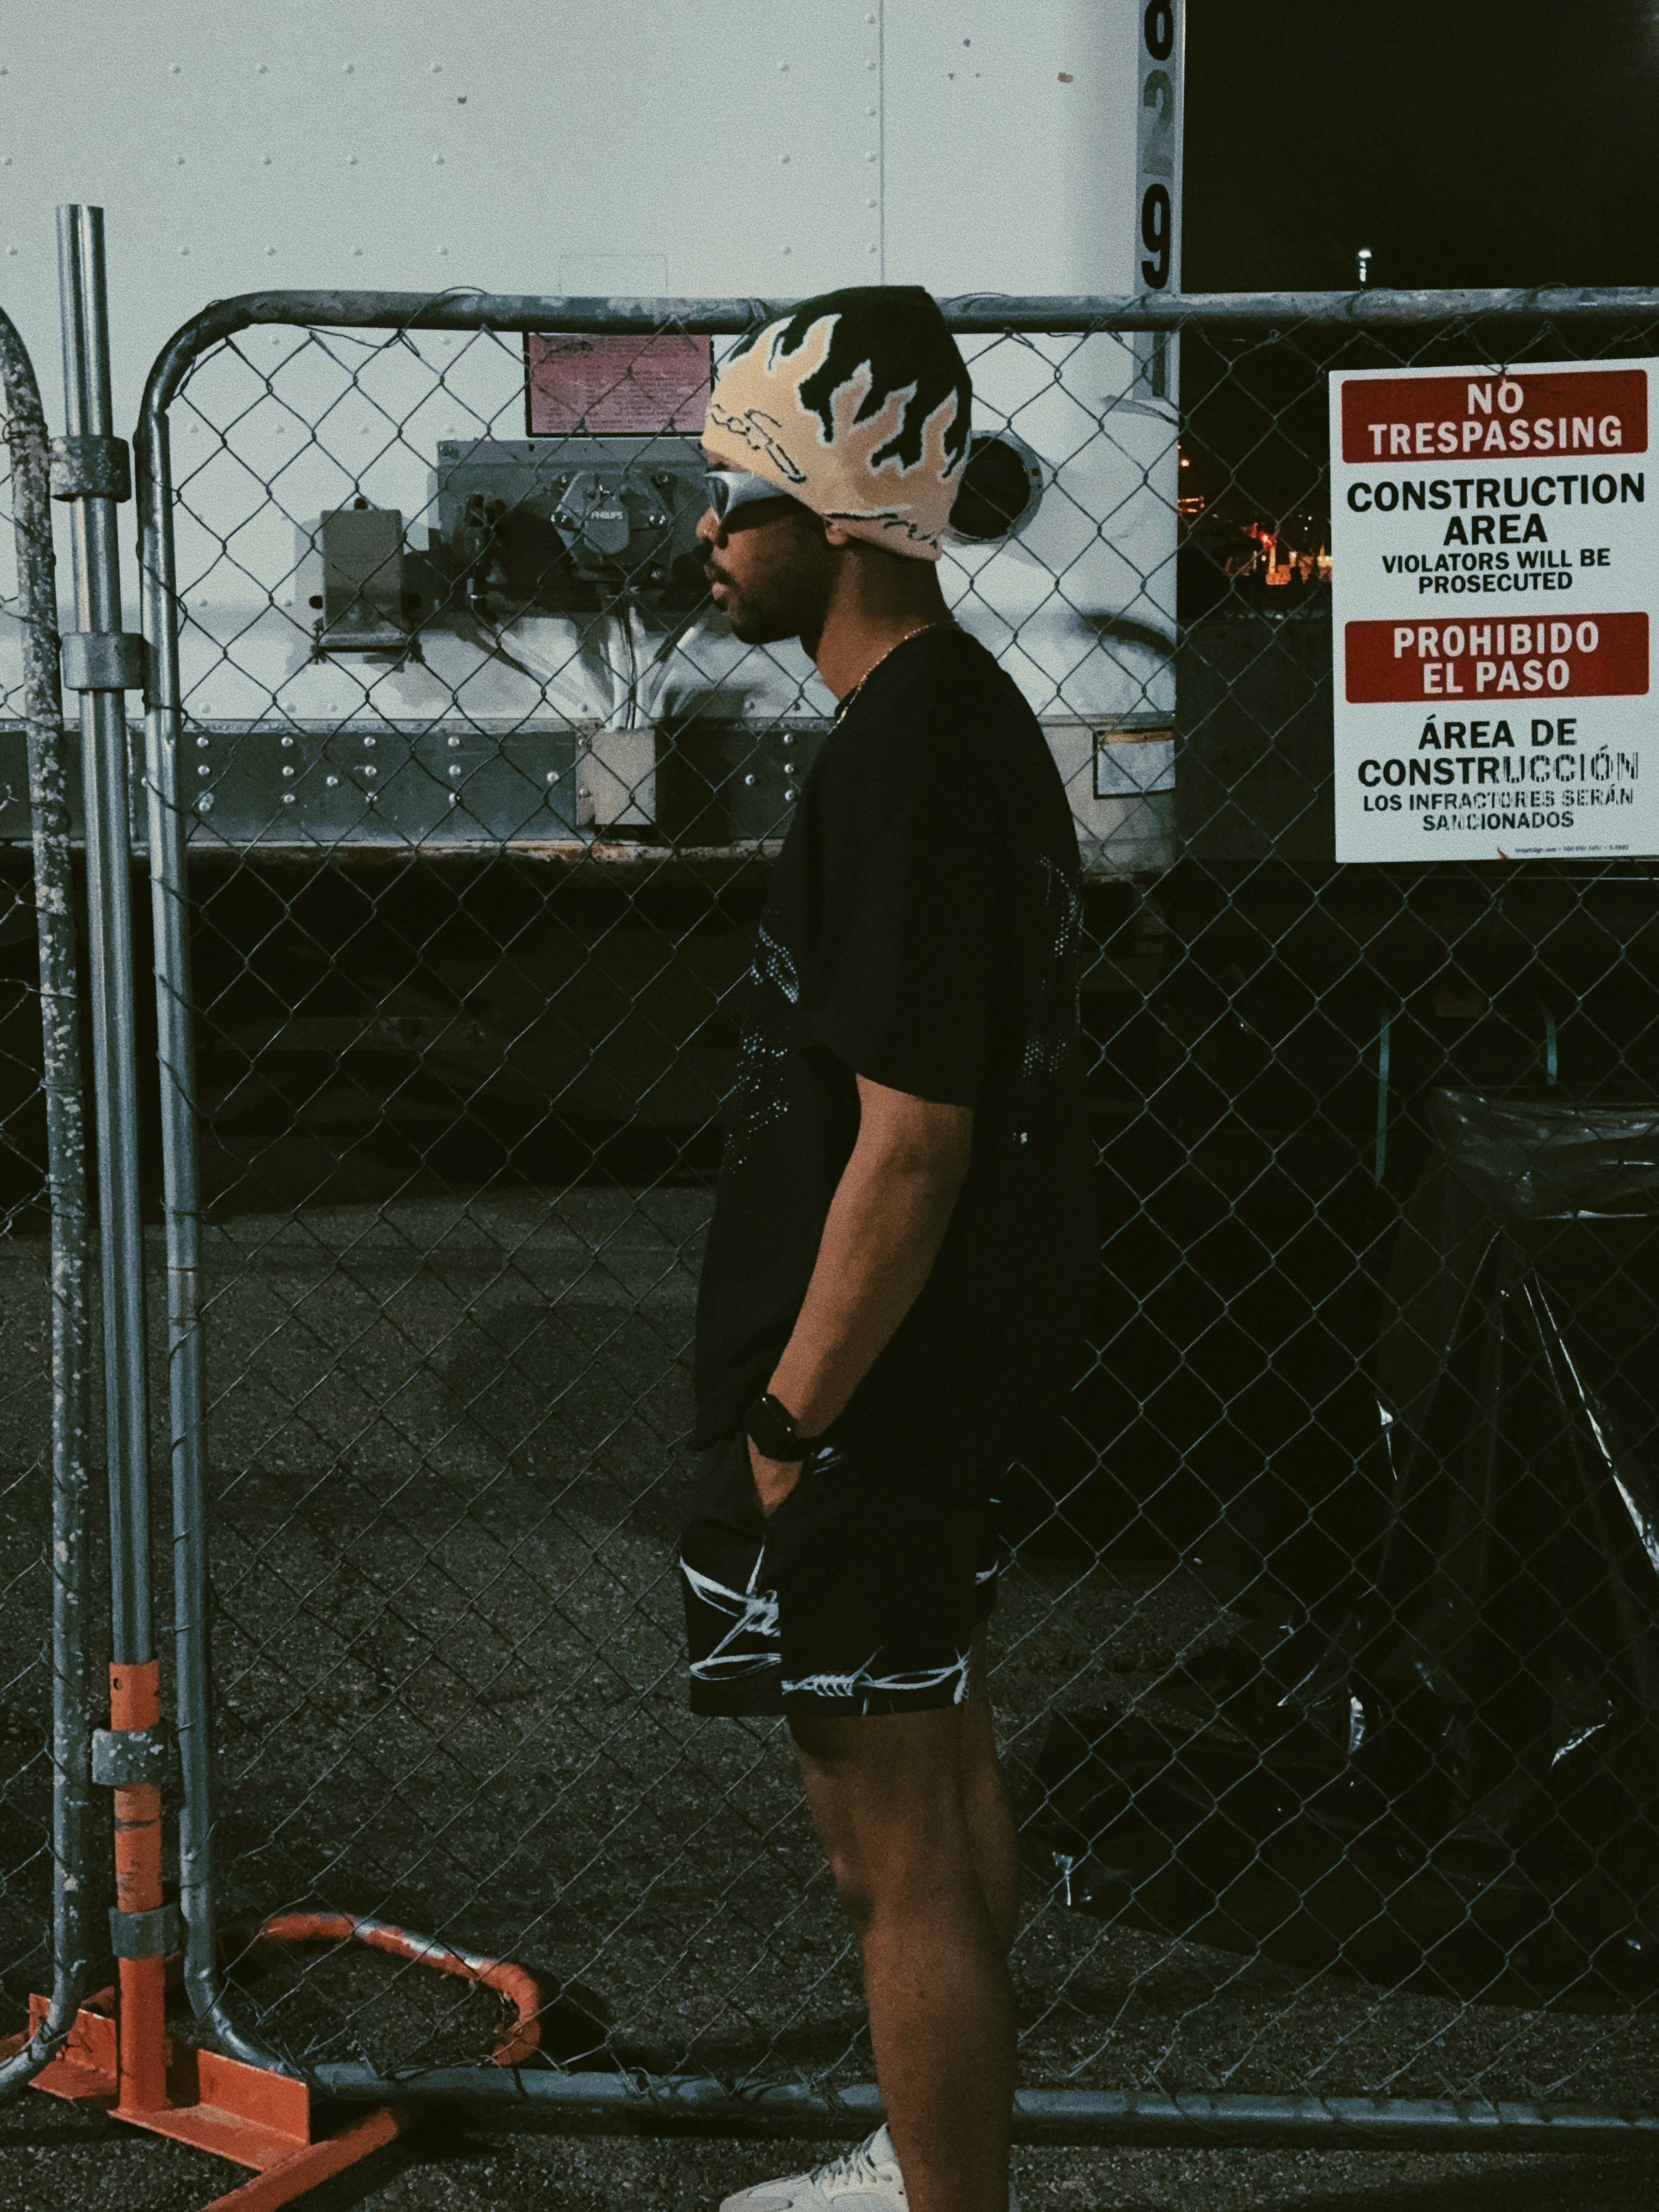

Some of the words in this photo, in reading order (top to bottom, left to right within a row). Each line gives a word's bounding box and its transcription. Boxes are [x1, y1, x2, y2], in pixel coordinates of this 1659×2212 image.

[1468, 382, 1523, 414] NO
[1368, 416, 1622, 455] TRESPASSING
[1348, 473, 1644, 512] CONSTRUCTION
[1443, 513, 1548, 546] AREA
[1382, 552, 1510, 573] VIOLATORS
[1517, 550, 1572, 569] WILL
[1580, 548, 1611, 566] BE
[1419, 572, 1573, 594] PROSECUTED
[1394, 621, 1599, 658] PROHIBIDO
[1424, 663, 1463, 694] EL
[1477, 659, 1570, 692] PASO
[1418, 714, 1515, 750] ÁREA
[1532, 718, 1577, 746] DE
[1358, 745, 1638, 787] CONSTRUCCIÓN
[1364, 795, 1402, 811] LOS
[1410, 791, 1555, 811] INFRACTORES
[1562, 784, 1633, 807] SERÁN
[1423, 811, 1574, 831] SANCIONADOS
